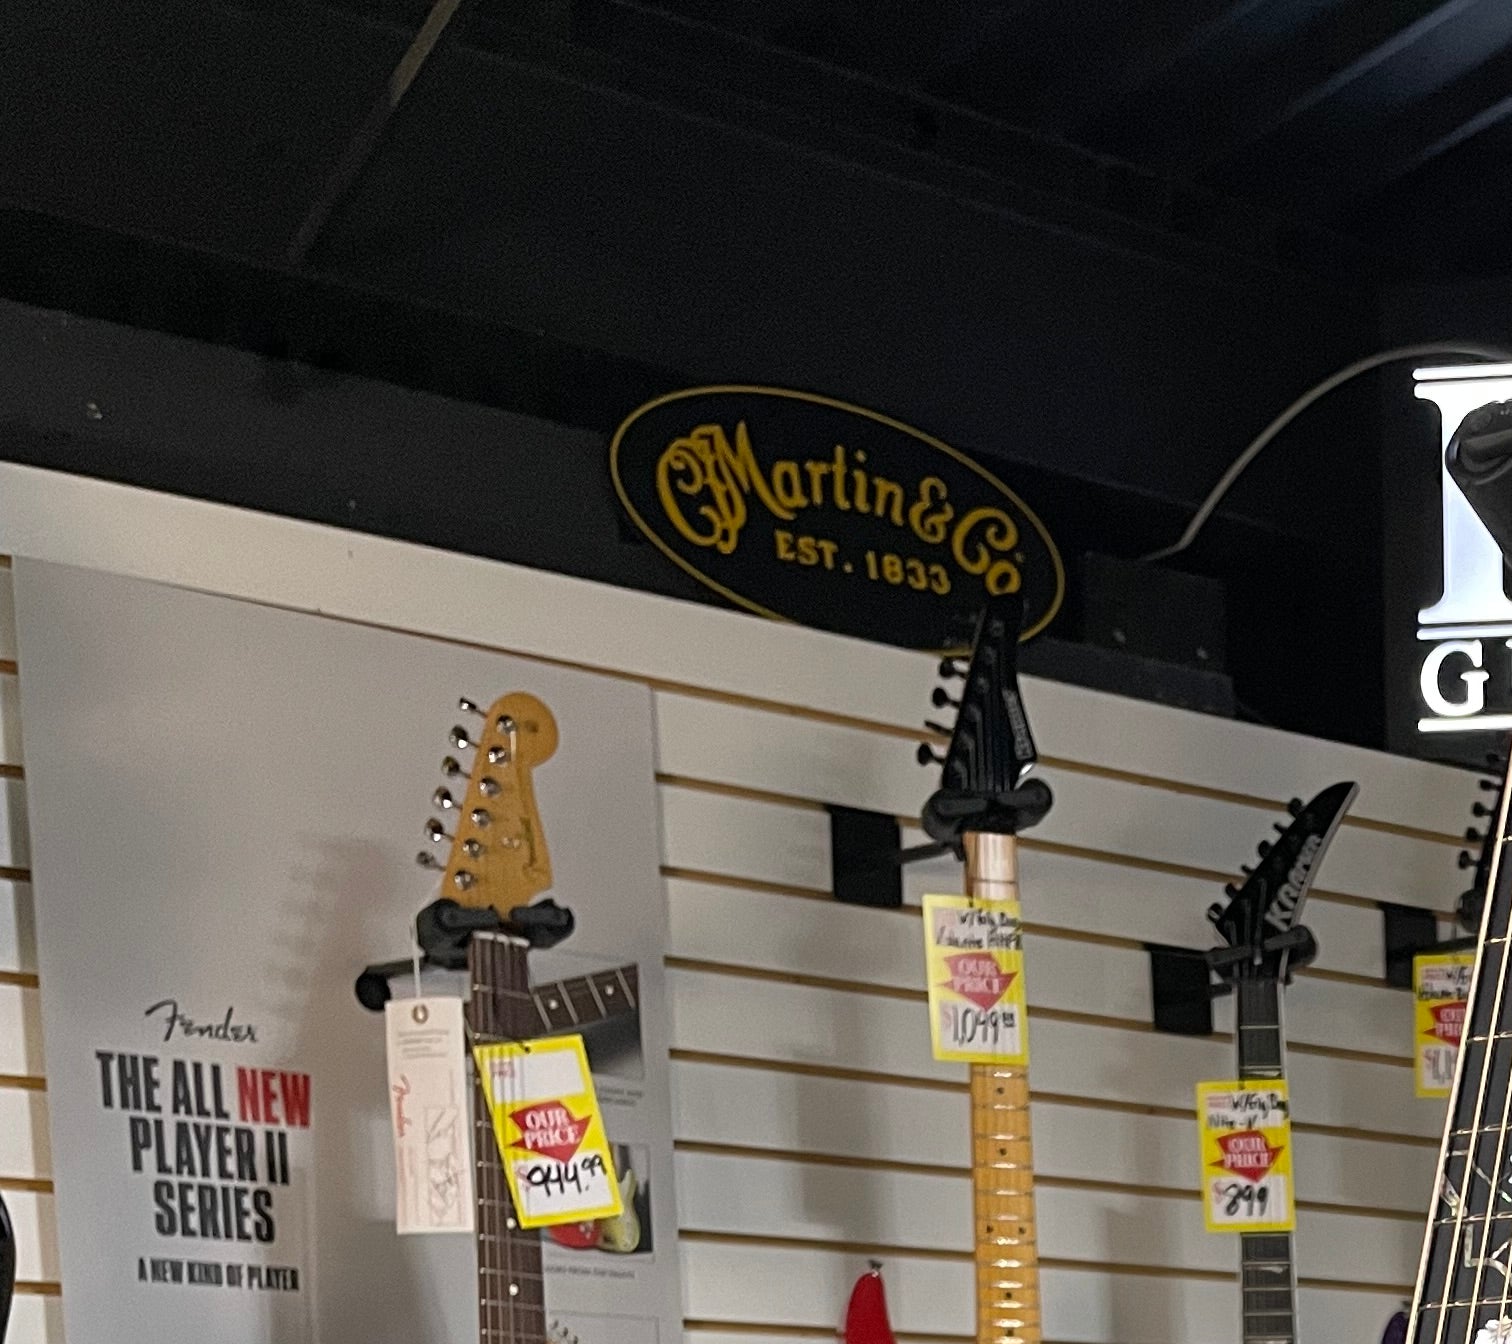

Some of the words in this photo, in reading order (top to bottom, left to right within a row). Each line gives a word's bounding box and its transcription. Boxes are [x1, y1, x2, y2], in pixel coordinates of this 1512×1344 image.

[774, 529, 853, 574] EST.
[865, 550, 951, 594] 1833
[958, 958, 998, 978] OUR
[952, 975, 1001, 994] PRICE
[145, 999, 257, 1042] Fender
[96, 1050, 162, 1112] THE
[172, 1058, 230, 1120] ALL
[236, 1066, 311, 1129] NEW
[525, 1107, 570, 1131] OUR
[129, 1116, 257, 1183] PLAYER
[265, 1130, 289, 1185] II
[524, 1125, 580, 1149] PRICE
[1228, 1136, 1266, 1151] OUR
[1224, 1153, 1272, 1168] PRICE
[154, 1180, 275, 1242] SERIES
[138, 1257, 148, 1282] A
[150, 1258, 184, 1284] NEW
[187, 1261, 223, 1287] KIND
[226, 1264, 243, 1288] OF
[247, 1265, 299, 1291] PLAYER
